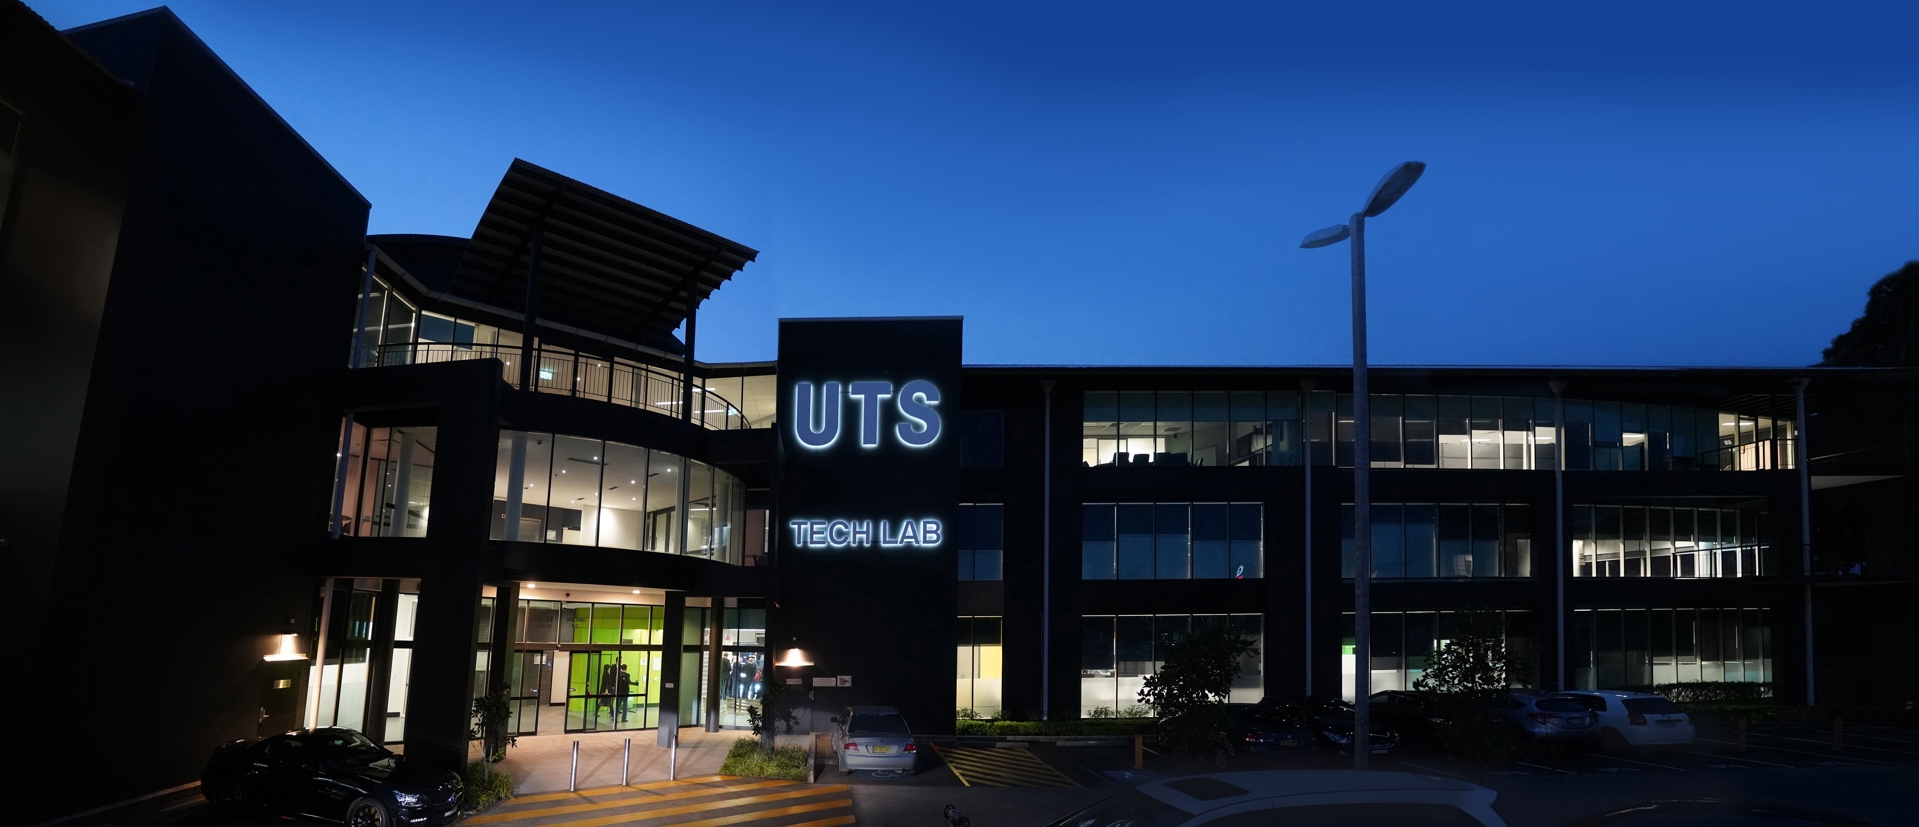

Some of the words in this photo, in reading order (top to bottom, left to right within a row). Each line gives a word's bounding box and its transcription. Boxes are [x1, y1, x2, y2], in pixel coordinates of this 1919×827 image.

[796, 380, 941, 447] UTS
[791, 520, 871, 546] TECH
[881, 520, 942, 546] LAB
